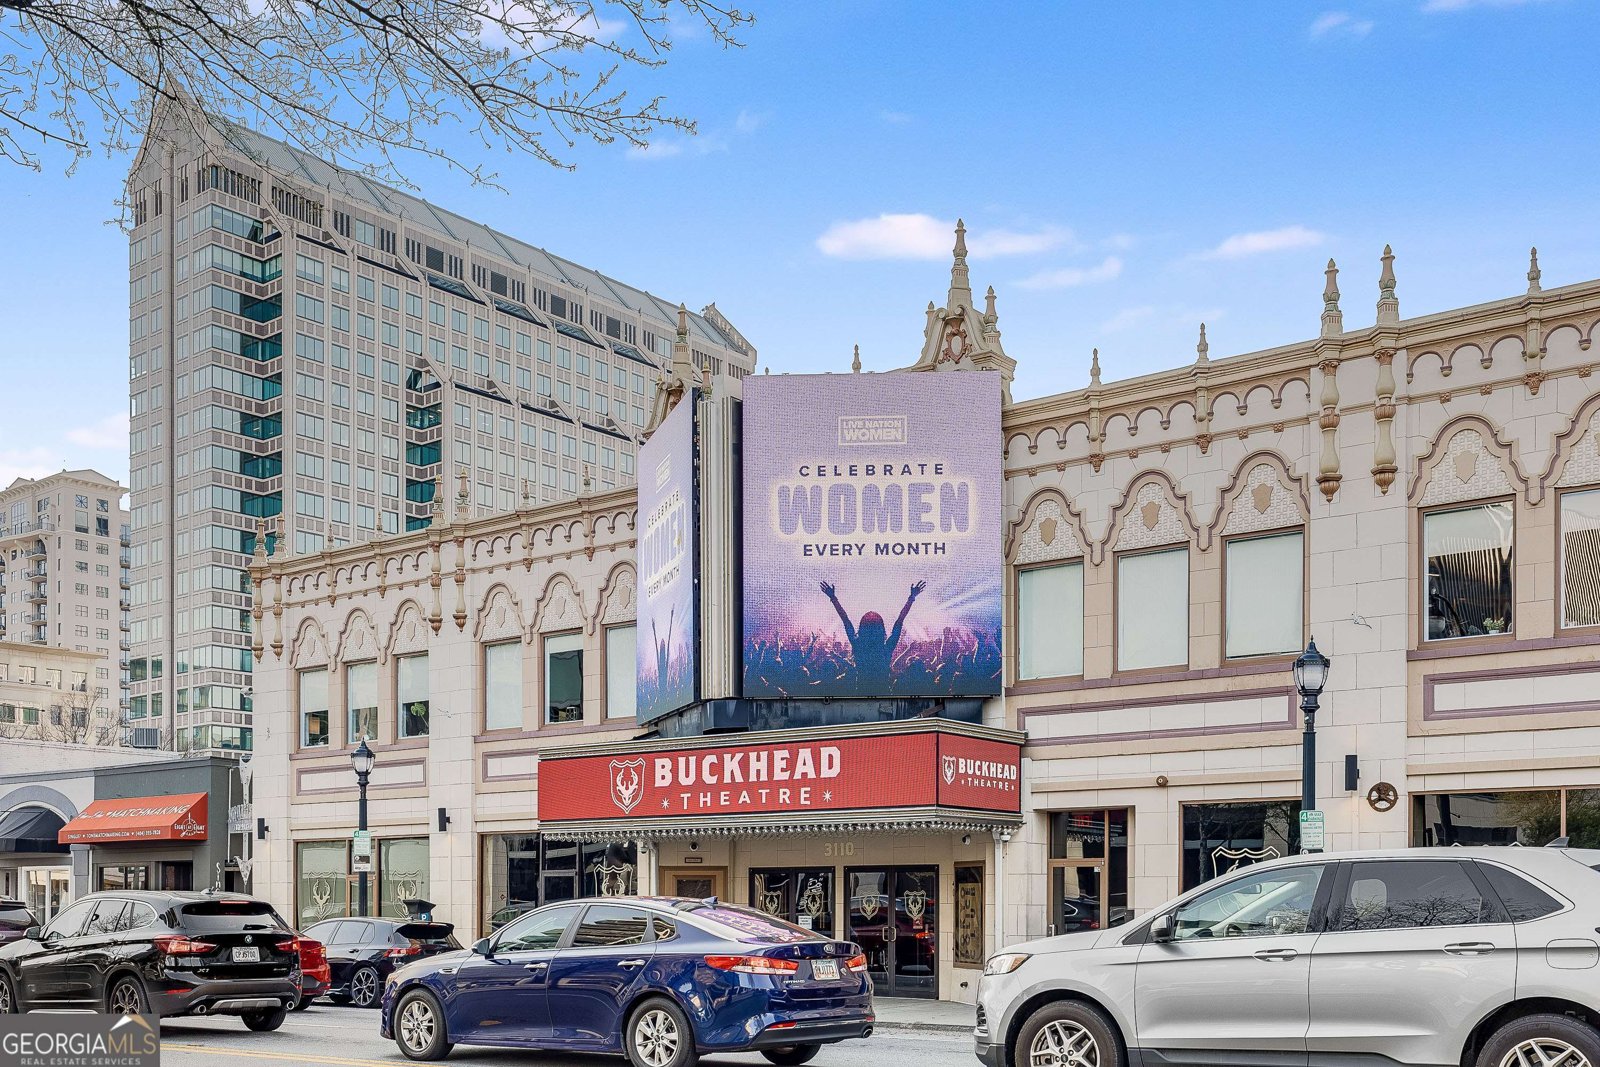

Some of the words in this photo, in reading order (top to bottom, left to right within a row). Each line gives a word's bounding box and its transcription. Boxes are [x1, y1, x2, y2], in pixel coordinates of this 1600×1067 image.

[843, 420, 864, 429] LIVE
[865, 419, 902, 428] NATION
[843, 428, 903, 441] WOMEN
[799, 463, 944, 477] CELEBRATE
[647, 490, 680, 529] CELEBRATE
[777, 481, 969, 536] WOMEN
[803, 543, 866, 557] EVERY
[874, 542, 946, 556] MONTH
[648, 576, 662, 598] EVERY
[662, 565, 680, 587] MONTH
[654, 746, 841, 788] BUCKHEAD
[958, 757, 1017, 780] BUCKHEAD
[968, 777, 1009, 791] THEATRE
[680, 787, 811, 810] THEATRE
[110, 804, 190, 818] MATCHMAKING
[1302, 812, 1308, 821] 4
[824, 842, 854, 857] 3110
